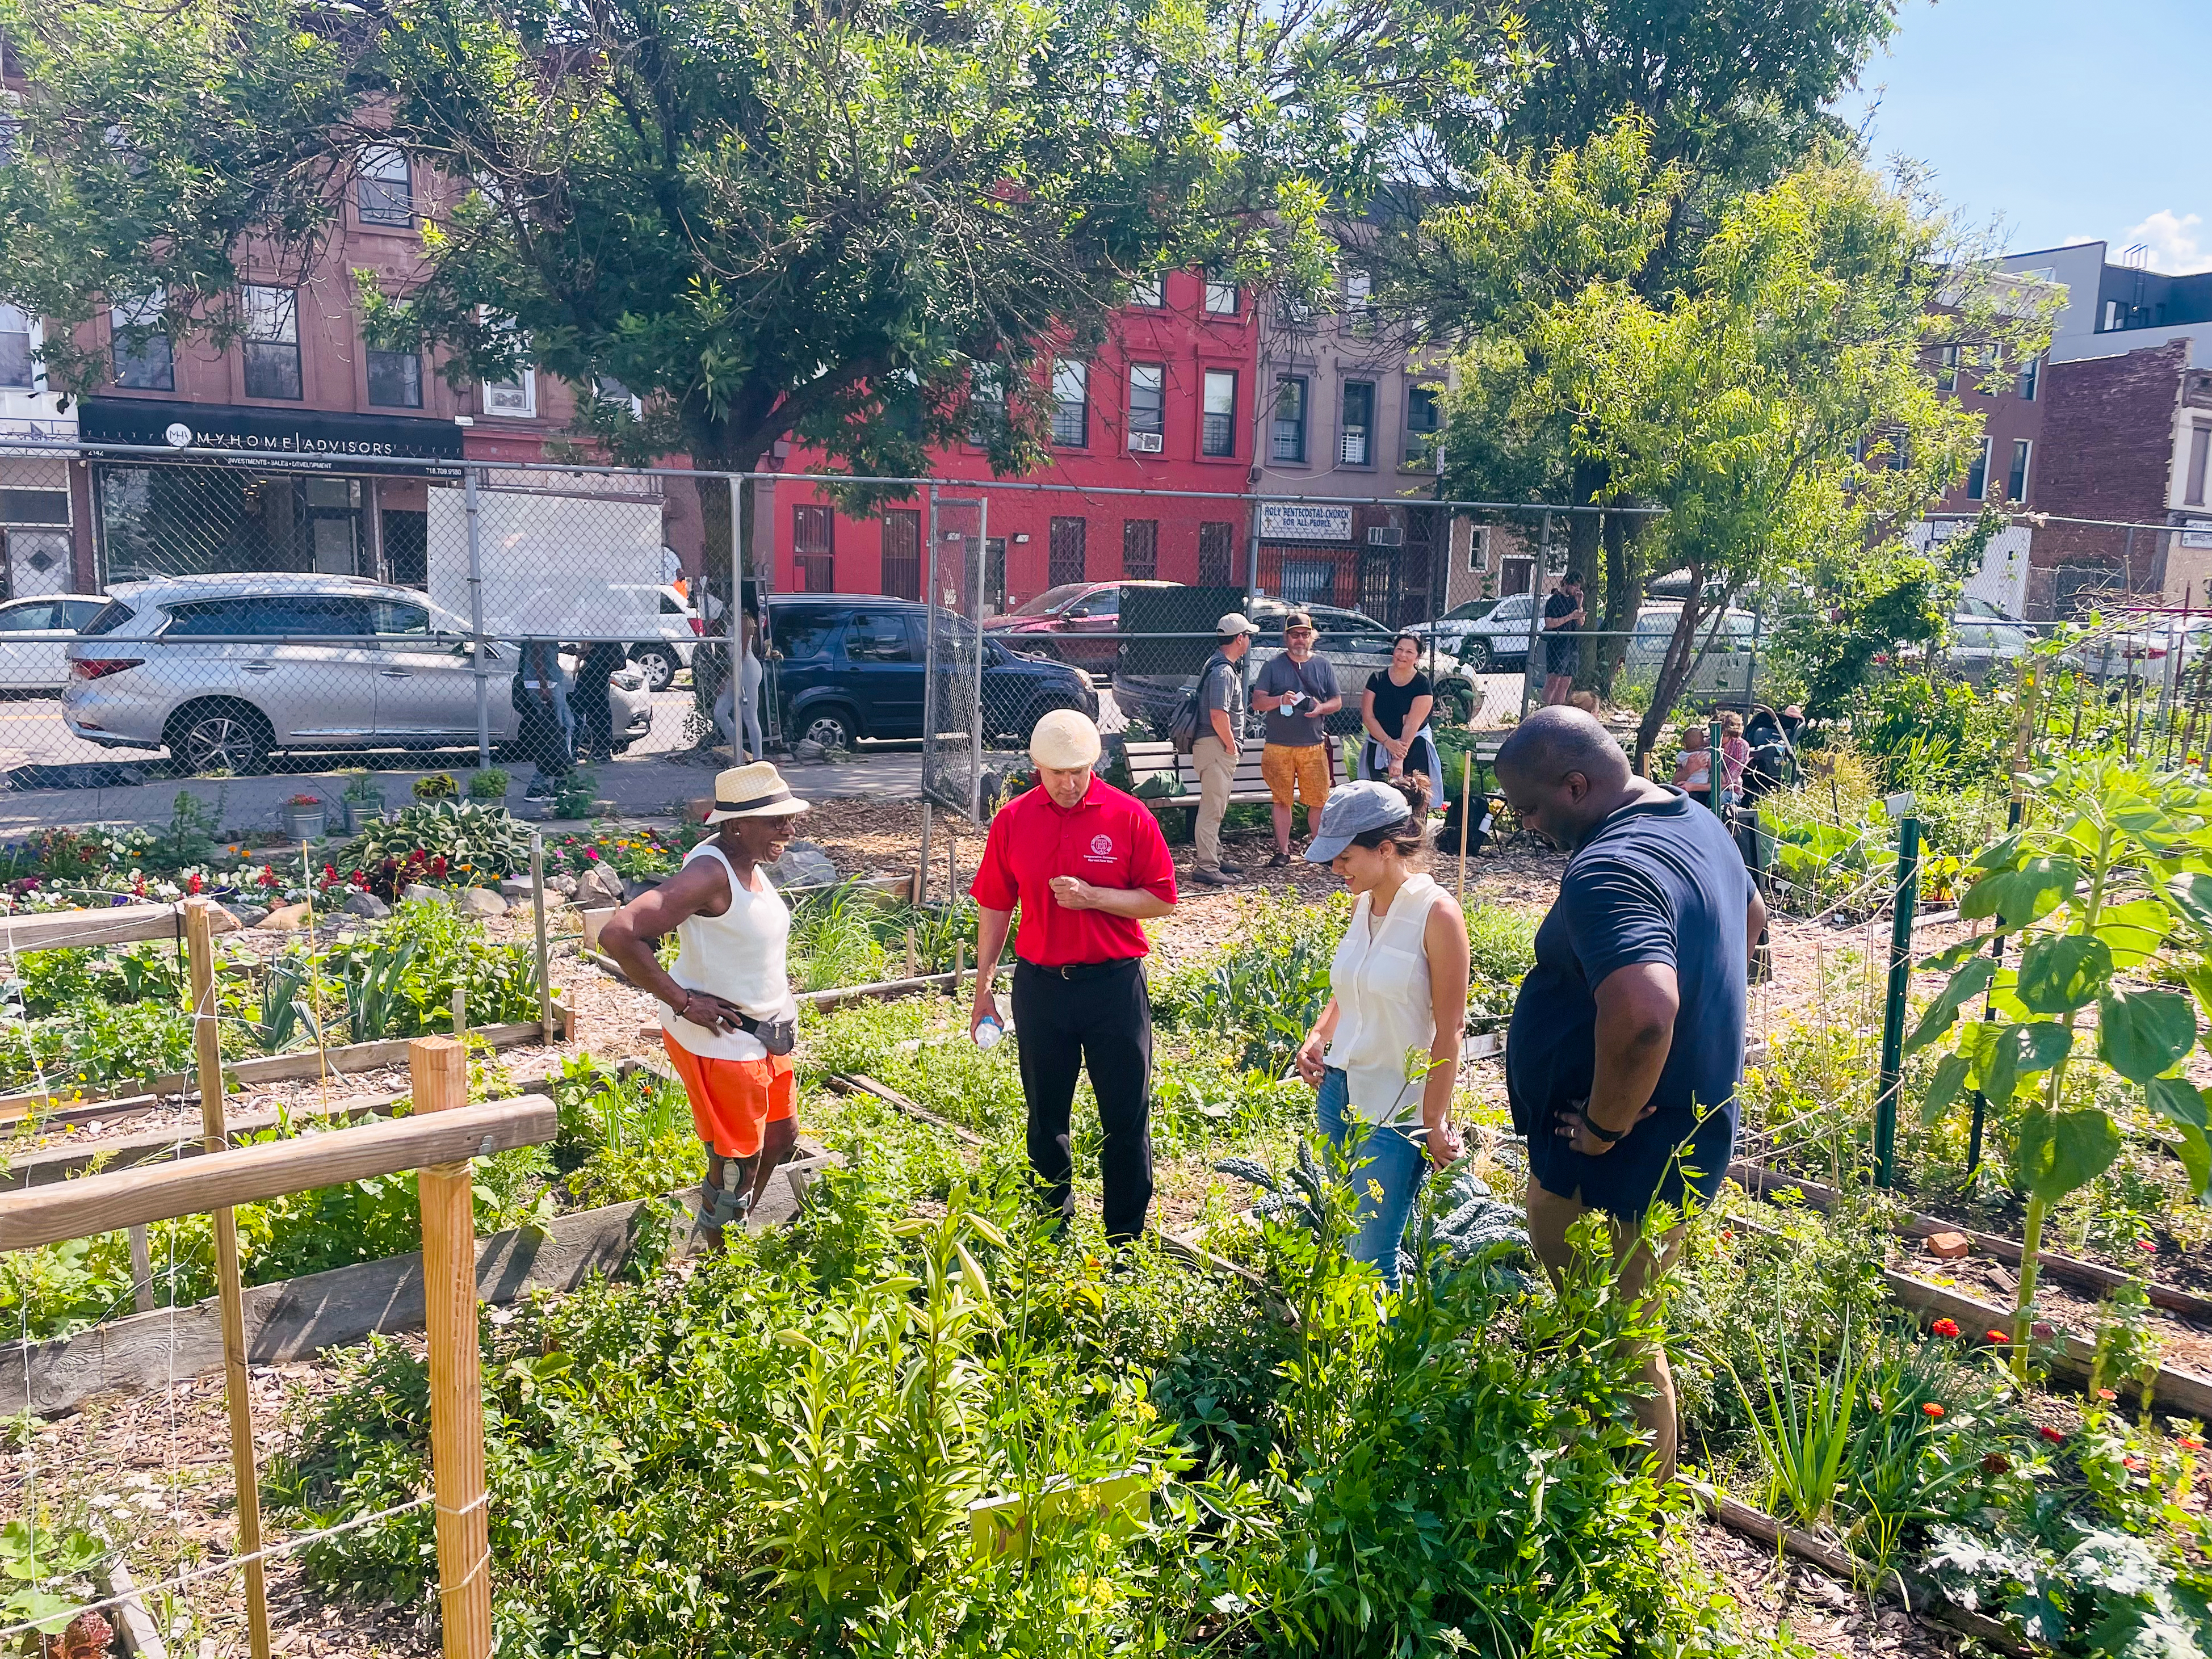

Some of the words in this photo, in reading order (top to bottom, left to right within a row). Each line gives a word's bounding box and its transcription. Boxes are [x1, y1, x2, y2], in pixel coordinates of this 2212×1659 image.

[304, 439, 392, 455] ADVISORS
[228, 457, 267, 466] INVESTMENTS
[1265, 506, 1281, 516] HOLY
[1283, 507, 1324, 518] PENTECOSTAL
[1325, 509, 1349, 518] CHURCH
